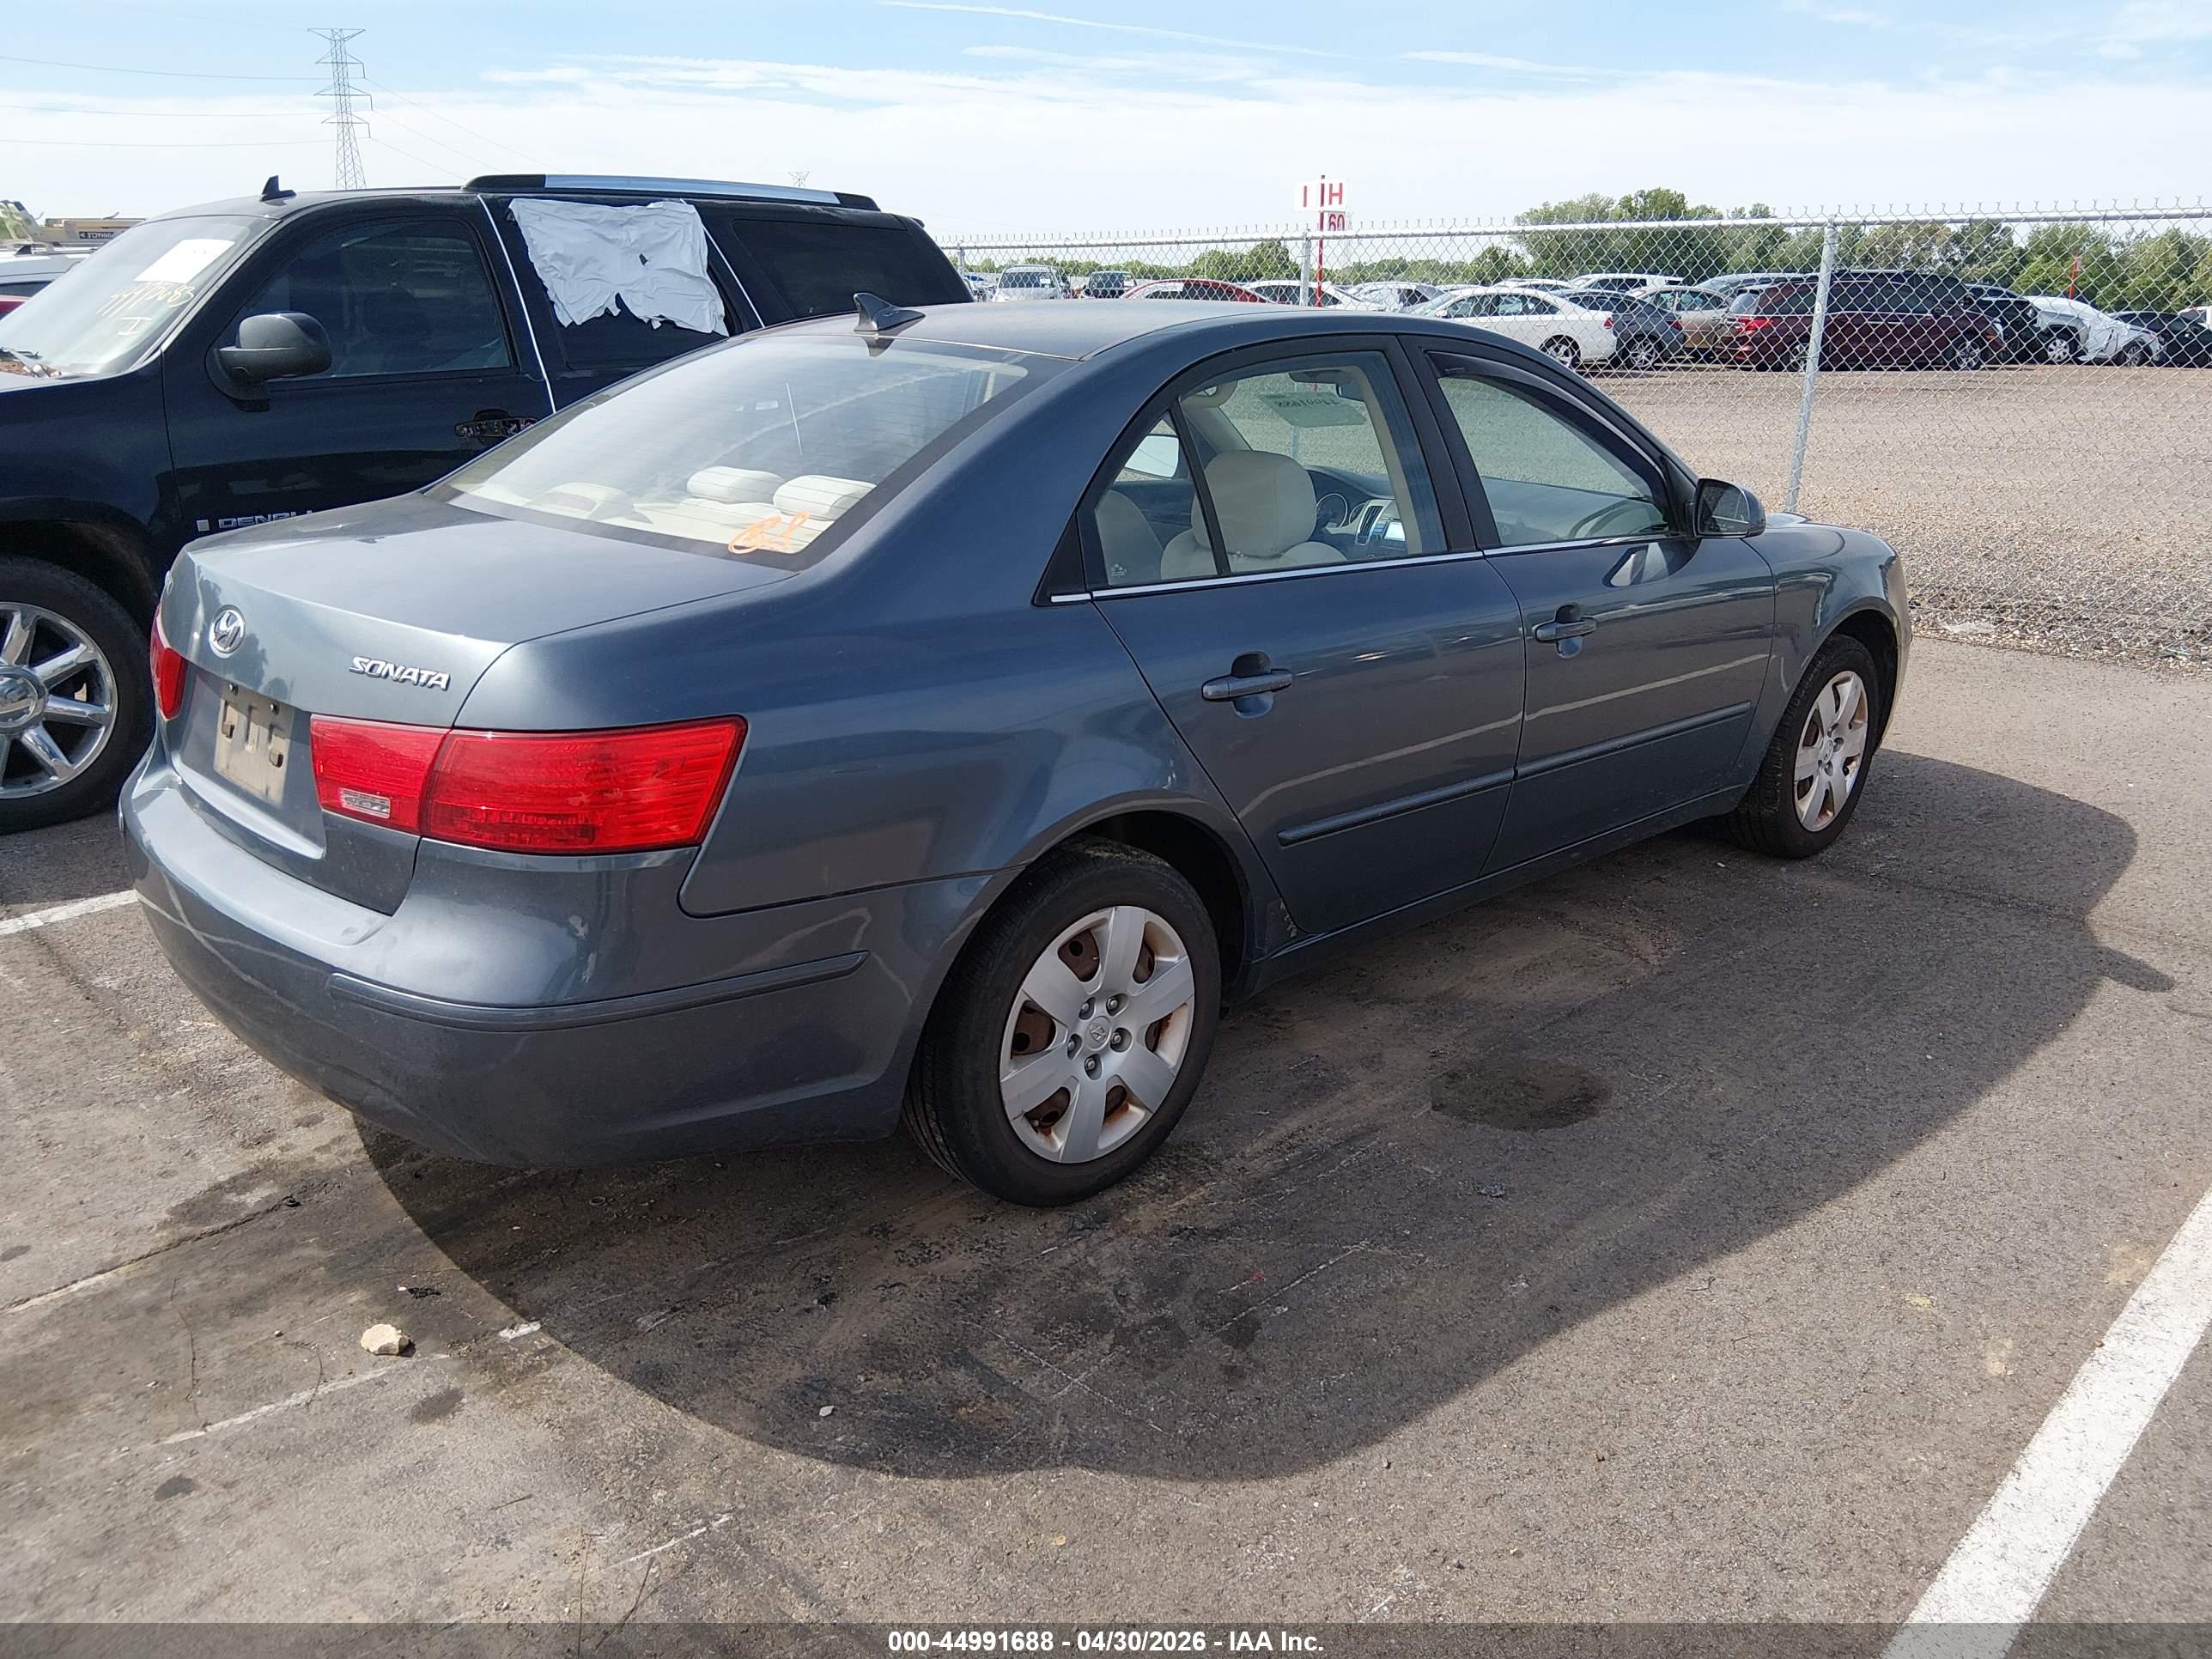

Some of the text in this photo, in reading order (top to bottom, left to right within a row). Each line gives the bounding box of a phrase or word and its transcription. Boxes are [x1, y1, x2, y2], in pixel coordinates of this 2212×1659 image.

[1328, 182, 1343, 205] H
[1328, 213, 1346, 232] 60
[349, 656, 451, 691] SONATA
